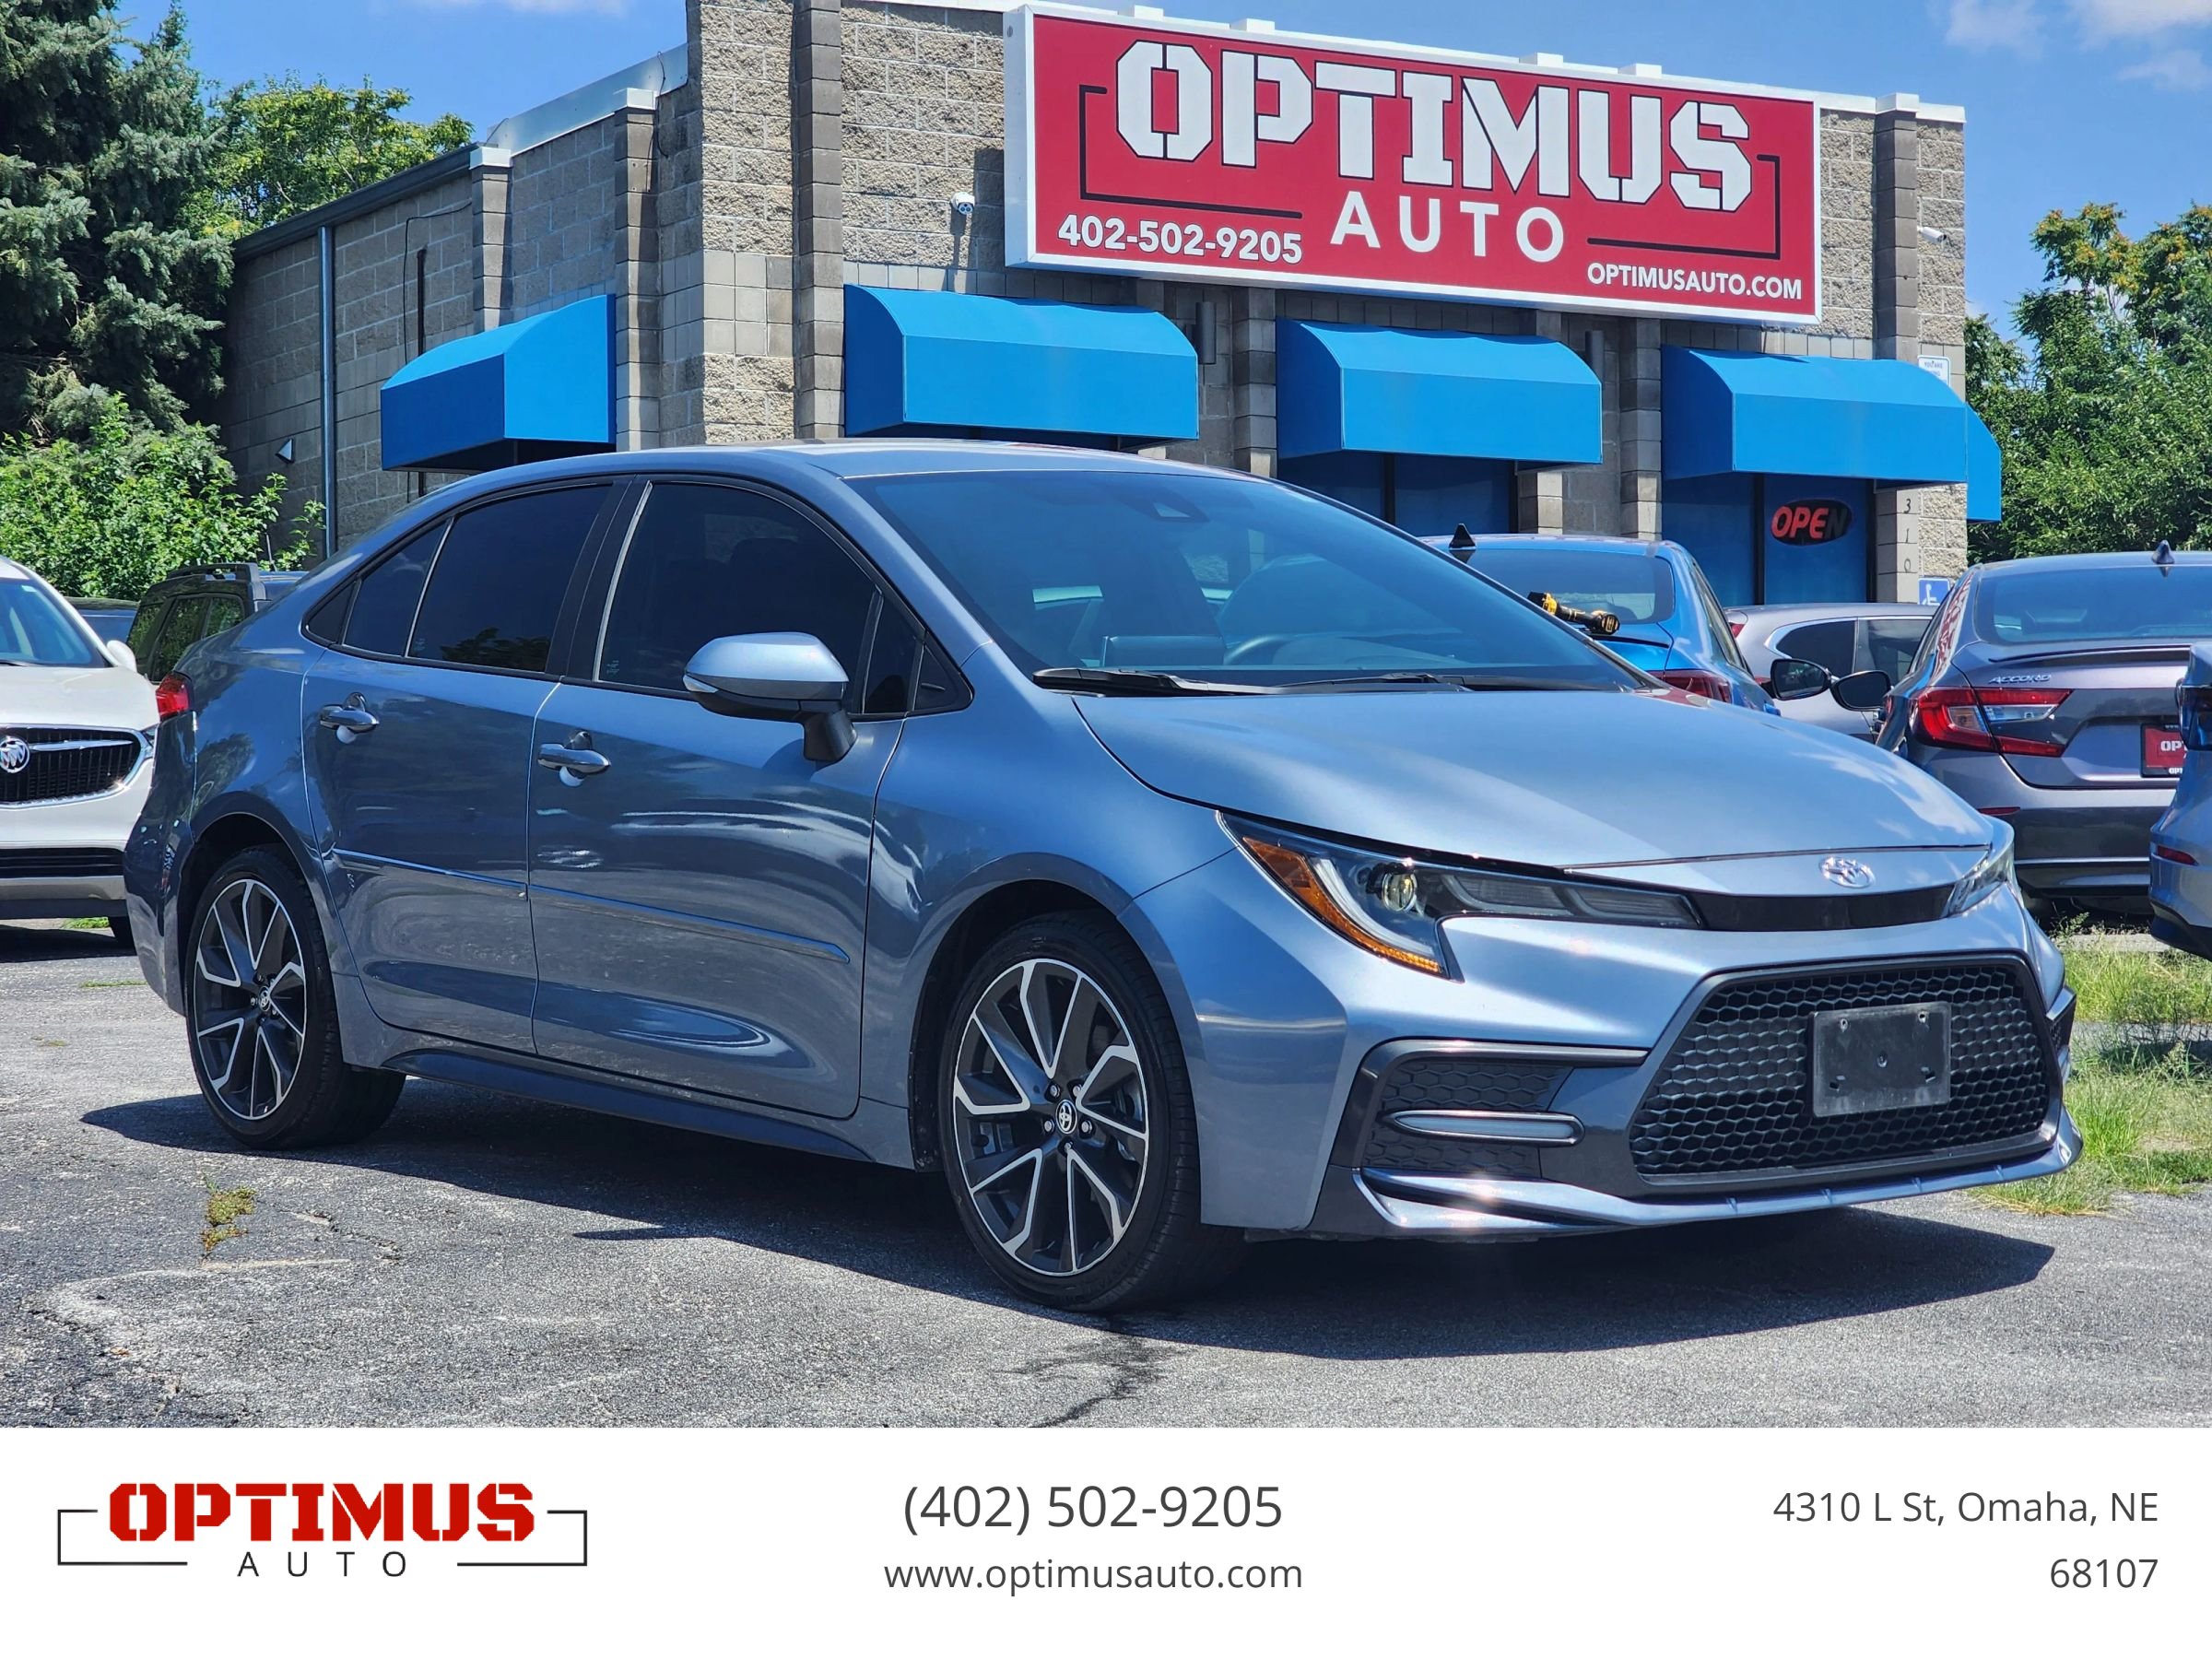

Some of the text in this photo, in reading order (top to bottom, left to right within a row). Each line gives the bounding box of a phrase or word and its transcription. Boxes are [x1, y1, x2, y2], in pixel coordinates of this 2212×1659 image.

[1116, 41, 1752, 212] OPTIMUS
[1057, 214, 1303, 265] 402-502-9205
[1330, 190, 1564, 263] AUTO
[1587, 262, 1803, 300] OPTIMUSAUTO.COM
[1771, 506, 1848, 539] OPEN
[1988, 674, 2052, 684] ACCORD
